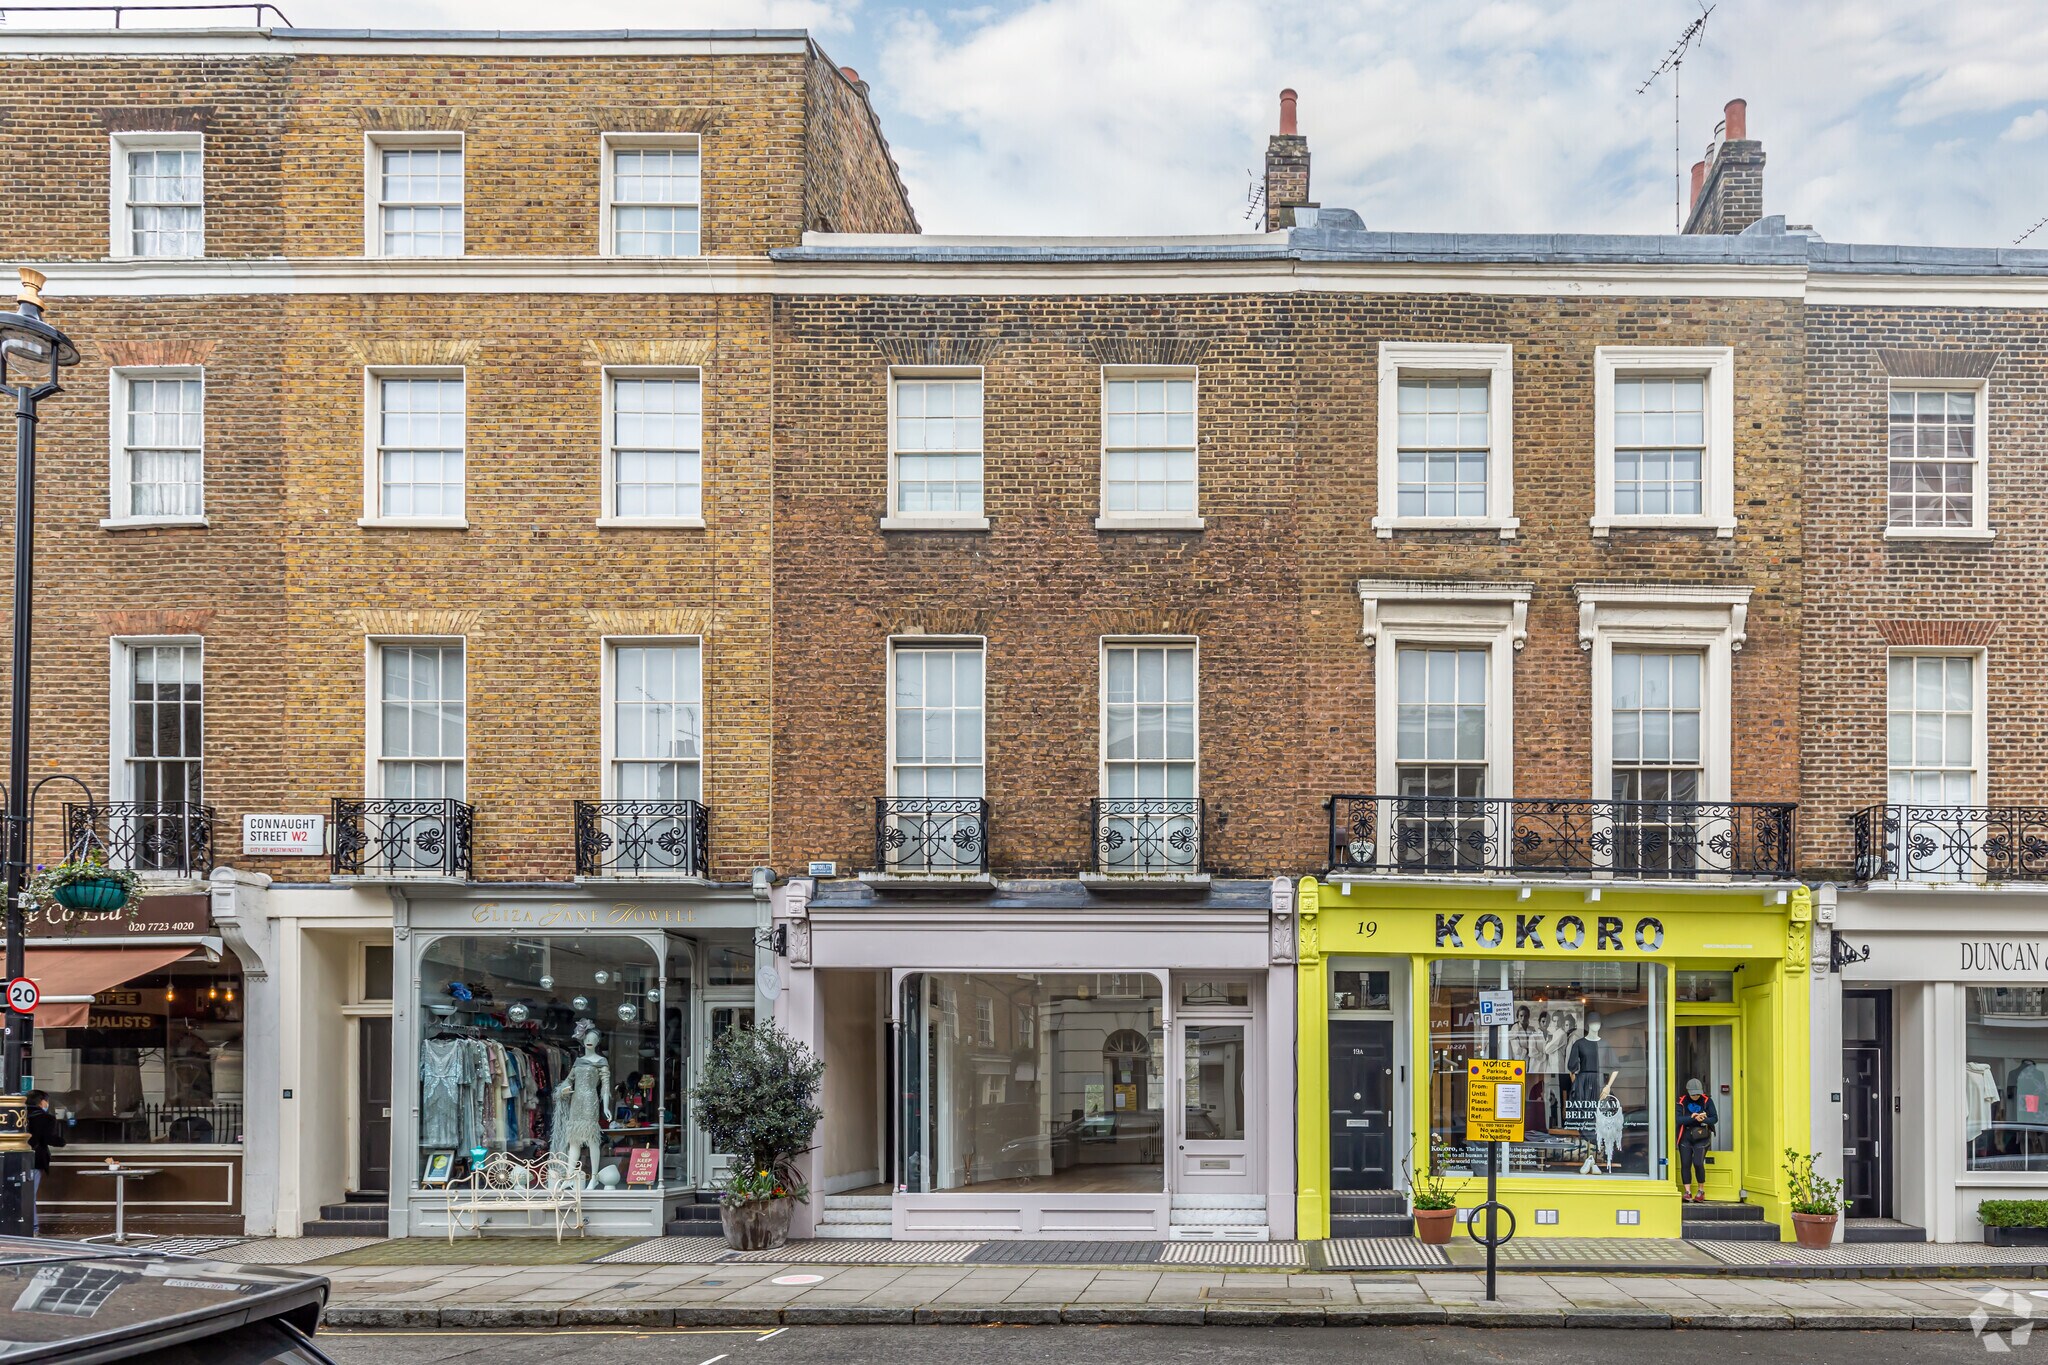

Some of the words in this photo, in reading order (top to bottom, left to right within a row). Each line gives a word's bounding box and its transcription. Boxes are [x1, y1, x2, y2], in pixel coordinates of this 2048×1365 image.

[250, 818, 316, 829] CONNAUGHT
[250, 831, 288, 842] STREET
[291, 831, 307, 842] W2
[472, 903, 533, 923] ELIZA
[538, 903, 600, 926] JANE
[607, 903, 697, 924] HOWELL
[128, 922, 146, 932] 020
[148, 922, 170, 931] 7723
[172, 921, 195, 931] 4020
[1357, 921, 1378, 938] 19
[1434, 913, 1665, 952] KOKORO
[1960, 942, 2040, 971] DUNCAN
[12, 988, 35, 1003] 20
[1484, 1002, 1491, 1012] P
